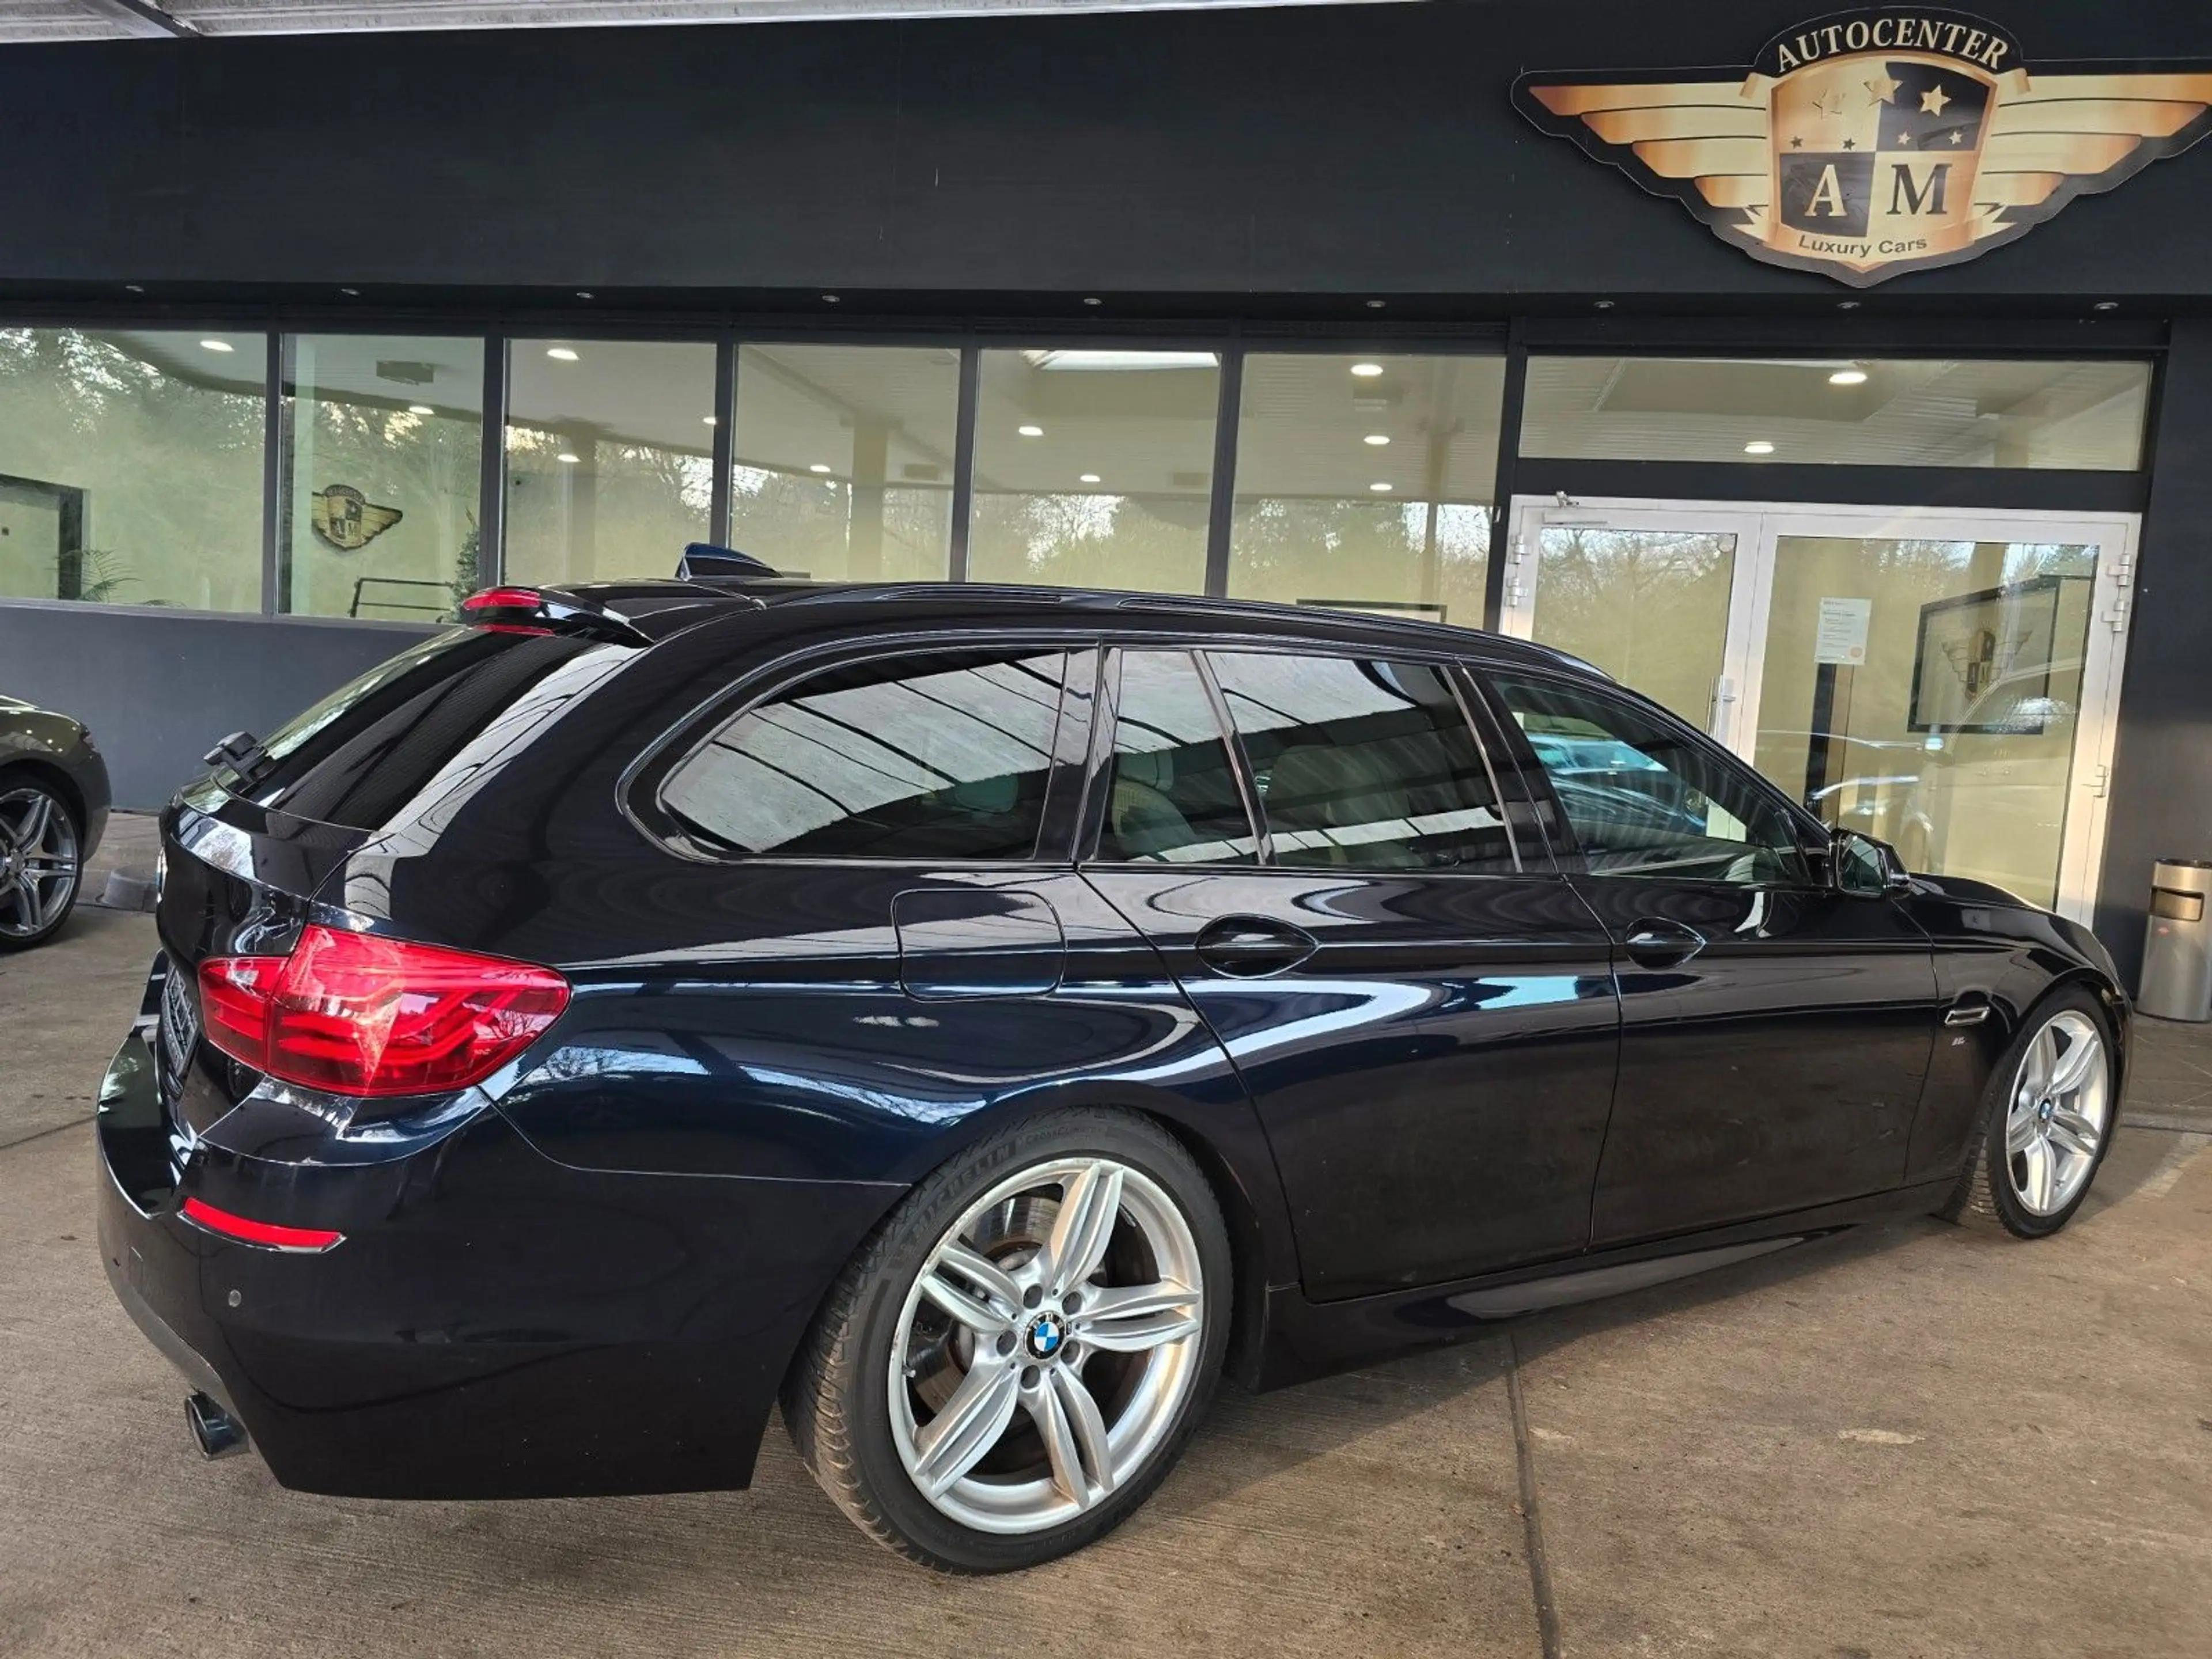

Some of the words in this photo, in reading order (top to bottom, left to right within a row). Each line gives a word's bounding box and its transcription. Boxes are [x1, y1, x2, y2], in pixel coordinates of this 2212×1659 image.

[1778, 18, 2009, 73] AUTOCENTER
[1804, 164, 1848, 217] A
[1885, 163, 1953, 215] M
[1798, 234, 1872, 258] Luxury
[1878, 238, 1927, 254] Cars
